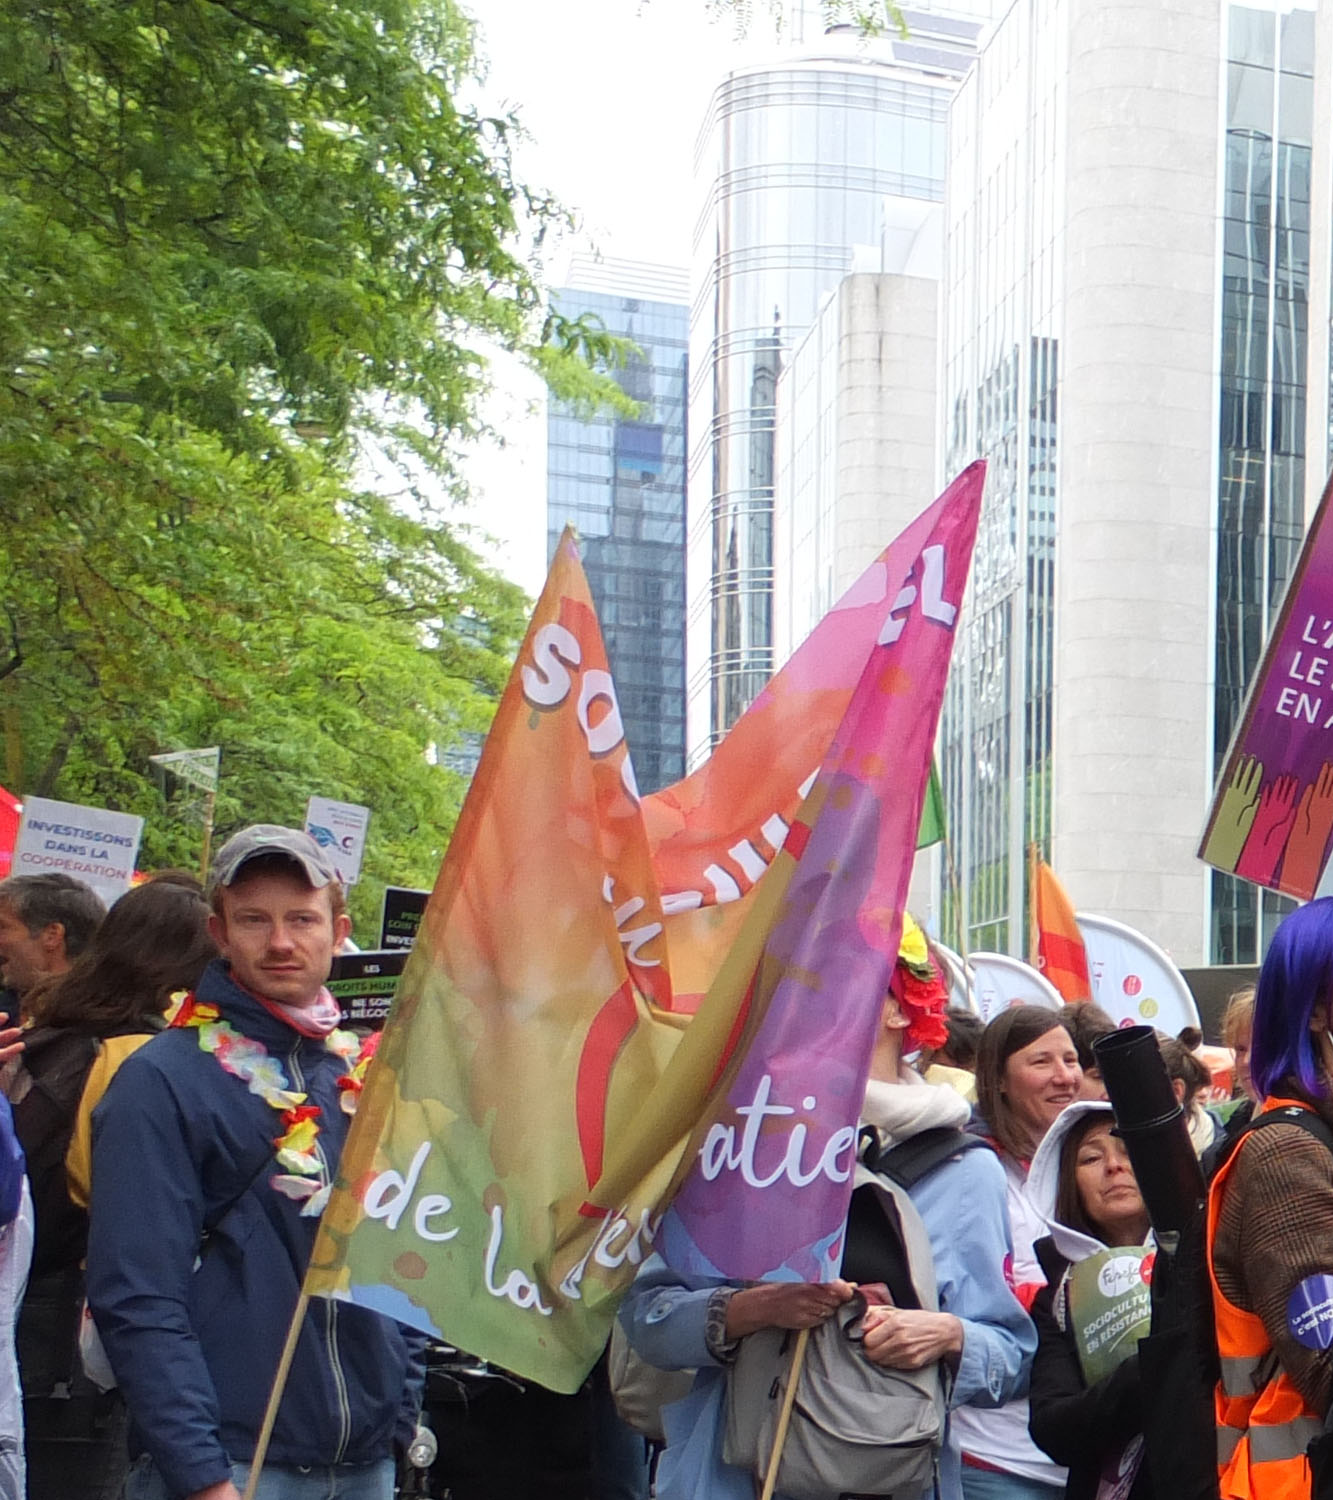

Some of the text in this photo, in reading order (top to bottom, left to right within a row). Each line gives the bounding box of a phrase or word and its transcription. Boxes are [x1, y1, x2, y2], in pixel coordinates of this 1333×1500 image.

[1289, 651, 1329, 687] LE
[1275, 687, 1322, 725] EN
[27, 818, 134, 848] INVESTISSONS
[44, 840, 109, 860] DANS LA
[362, 1140, 459, 1241] de
[1083, 1293, 1148, 1339] SOCIOCULTU
[1100, 1305, 1149, 1344] RÉSISTAN
